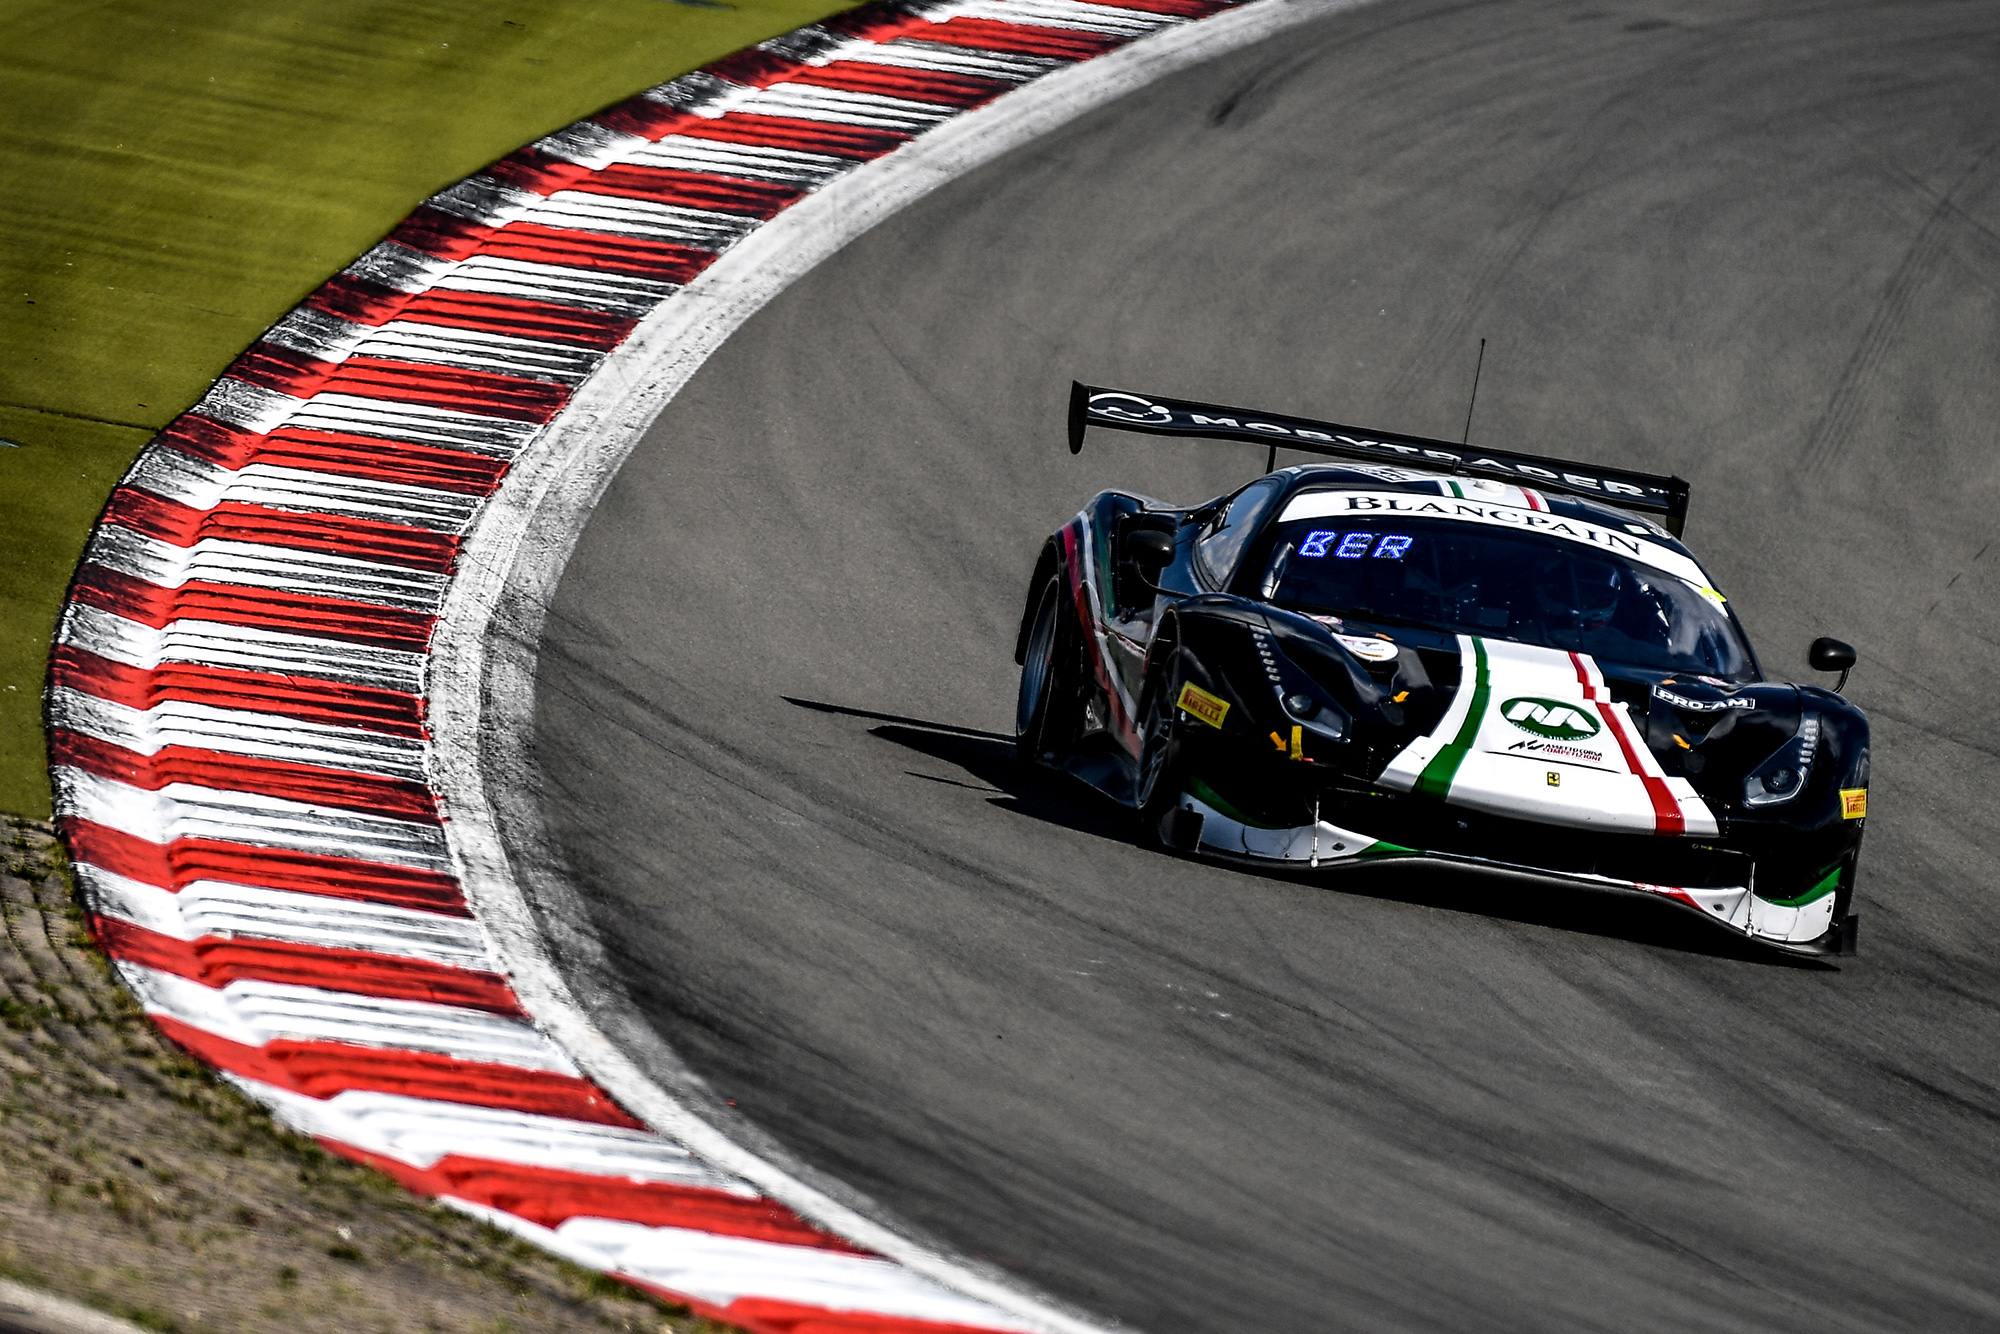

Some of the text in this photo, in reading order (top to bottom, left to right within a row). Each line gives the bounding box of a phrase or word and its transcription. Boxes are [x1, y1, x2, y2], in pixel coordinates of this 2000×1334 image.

[1345, 496, 1646, 556] BLANCPAIN
[1298, 531, 1414, 559] BER
[1183, 688, 1223, 722] PIRELLI
[1658, 689, 1749, 710] PRO-AM
